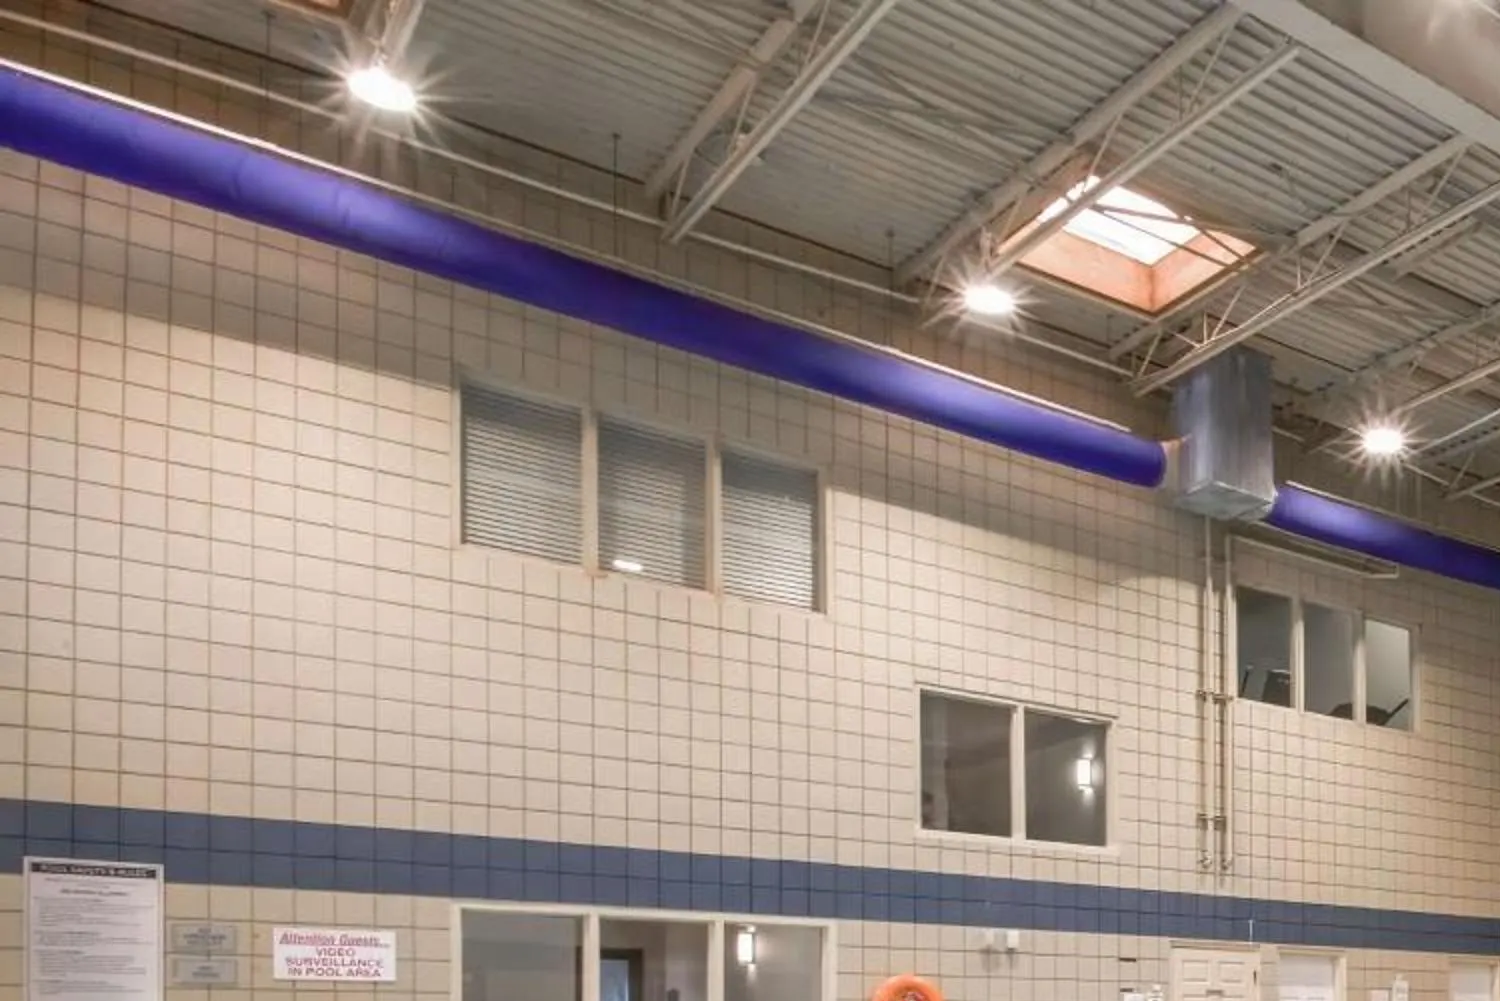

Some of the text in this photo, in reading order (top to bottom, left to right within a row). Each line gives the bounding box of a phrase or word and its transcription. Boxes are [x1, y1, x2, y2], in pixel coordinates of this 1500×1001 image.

[316, 948, 356, 957] VIDEO
[285, 958, 384, 968] SURVEILLANCE
[305, 968, 343, 977] POOL
[346, 967, 381, 977] AREA
